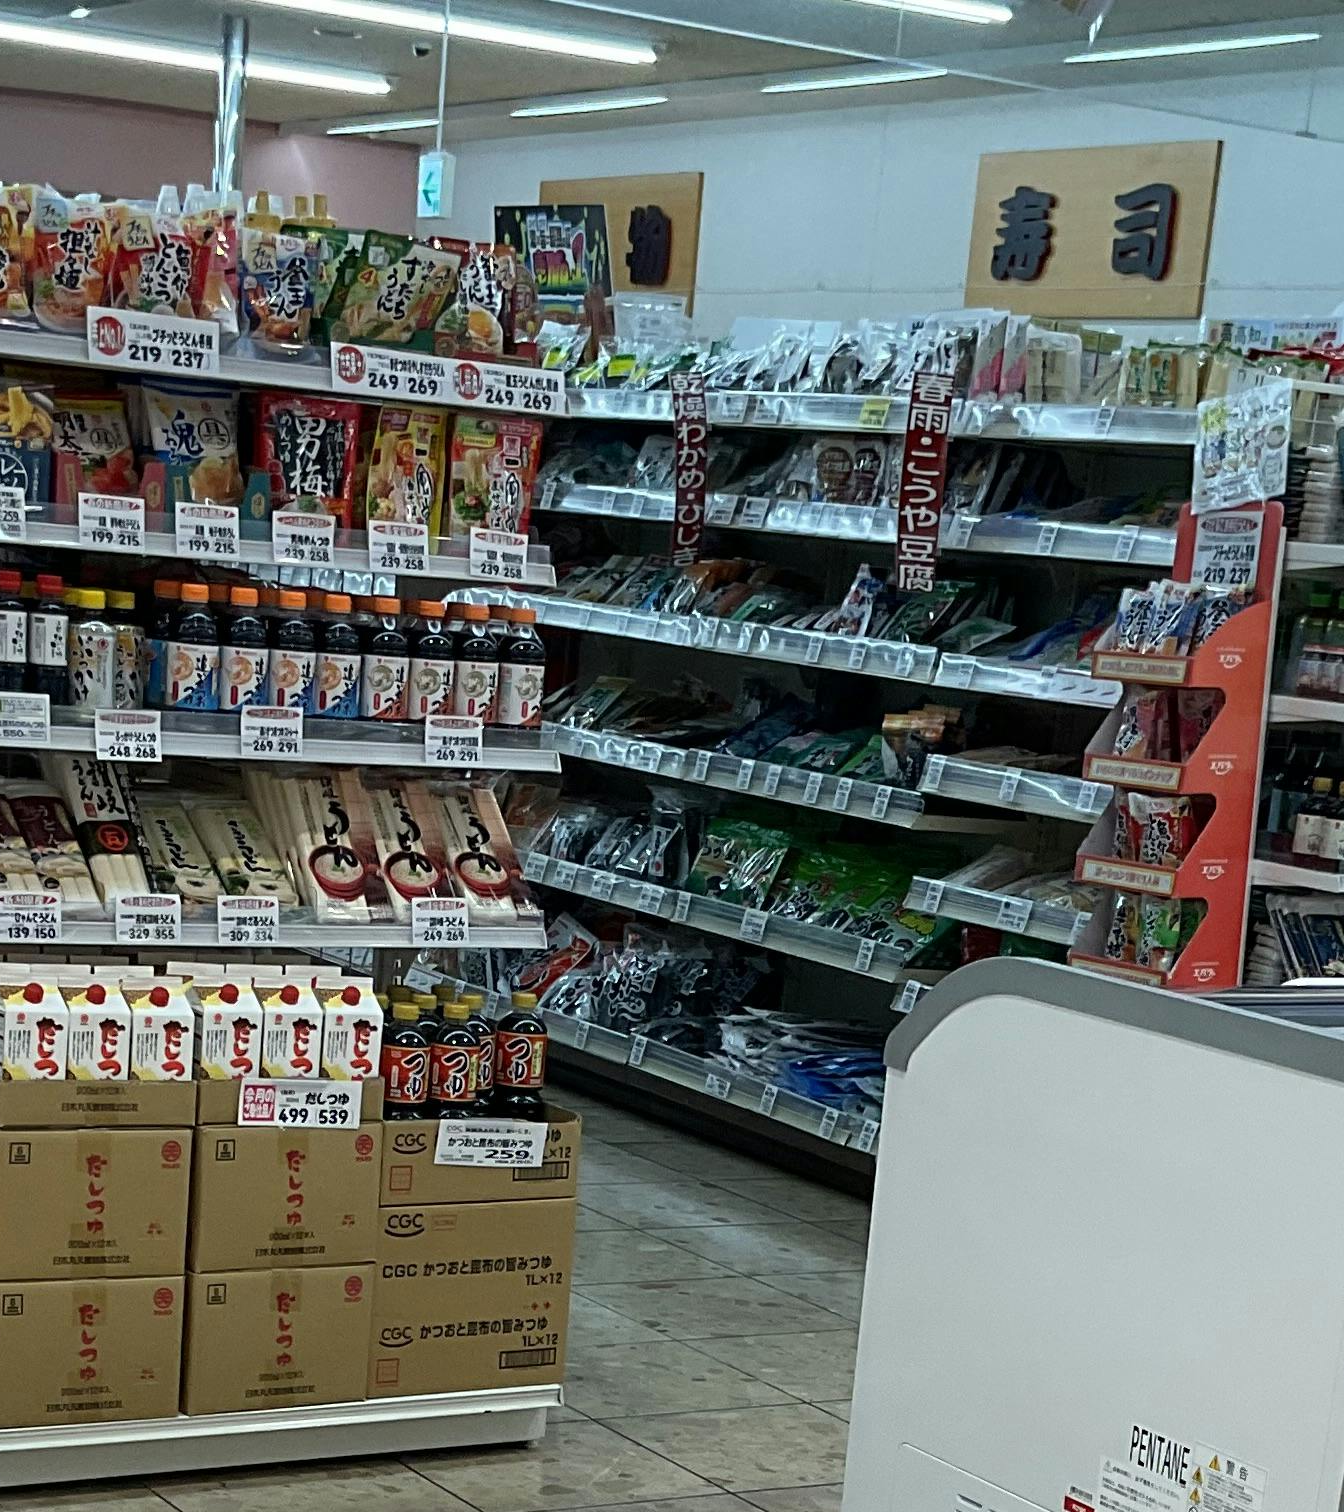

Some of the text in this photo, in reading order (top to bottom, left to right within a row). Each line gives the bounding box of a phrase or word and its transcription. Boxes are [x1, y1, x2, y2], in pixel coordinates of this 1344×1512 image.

[989, 183, 1179, 281] 寿司
[128, 344, 204, 369] 219 237
[368, 372, 438, 396] 249 269
[485, 388, 552, 412] 249 269
[292, 415, 328, 497] 男梅
[898, 373, 954, 593] 春雨・こうや豆腐
[2, 511, 20, 522] 259
[91, 529, 140, 547] 199 215
[189, 539, 236, 555] 199 215
[285, 547, 330, 562] 239 258
[380, 555, 425, 571] 239 258
[480, 562, 523, 580] 239 258
[1203, 567, 1251, 584] 219 237
[3, 729, 24, 738] 550
[109, 745, 157, 759] 248 268
[253, 740, 298, 754] 269 291
[436, 749, 479, 762] 269 291
[7, 927, 57, 939] 139 150
[129, 928, 176, 940] 329 355
[230, 931, 273, 942] 309 334
[423, 930, 465, 942] 249 269
[33, 1016, 64, 1079] だしつ
[96, 1017, 126, 1079] だしつ
[161, 1019, 189, 1080] だしつ
[230, 1015, 258, 1079] だしつ
[289, 1016, 317, 1078] だしつ
[350, 1017, 378, 1079] だしつ
[505, 1038, 533, 1080] つゆ
[402, 1050, 429, 1098] つゆ
[440, 1050, 469, 1097] つゆ
[305, 1092, 350, 1106] だしつゆ
[278, 1107, 349, 1125] 499 539
[394, 1132, 427, 1154] CGC
[484, 1149, 530, 1159] 259
[86, 1153, 107, 1234] だしつゆ
[285, 1149, 305, 1227] だしつゆ
[385, 1213, 426, 1238] CGC
[382, 1255, 553, 1279] CGC かつおと昆布の旨みつゆ
[276, 1291, 296, 1367] だしつゆ
[379, 1317, 548, 1348] CGC かつおと昆布の旨みつゆ
[78, 1303, 100, 1382] だしつゆ
[1129, 1425, 1191, 1486] PENTANE
